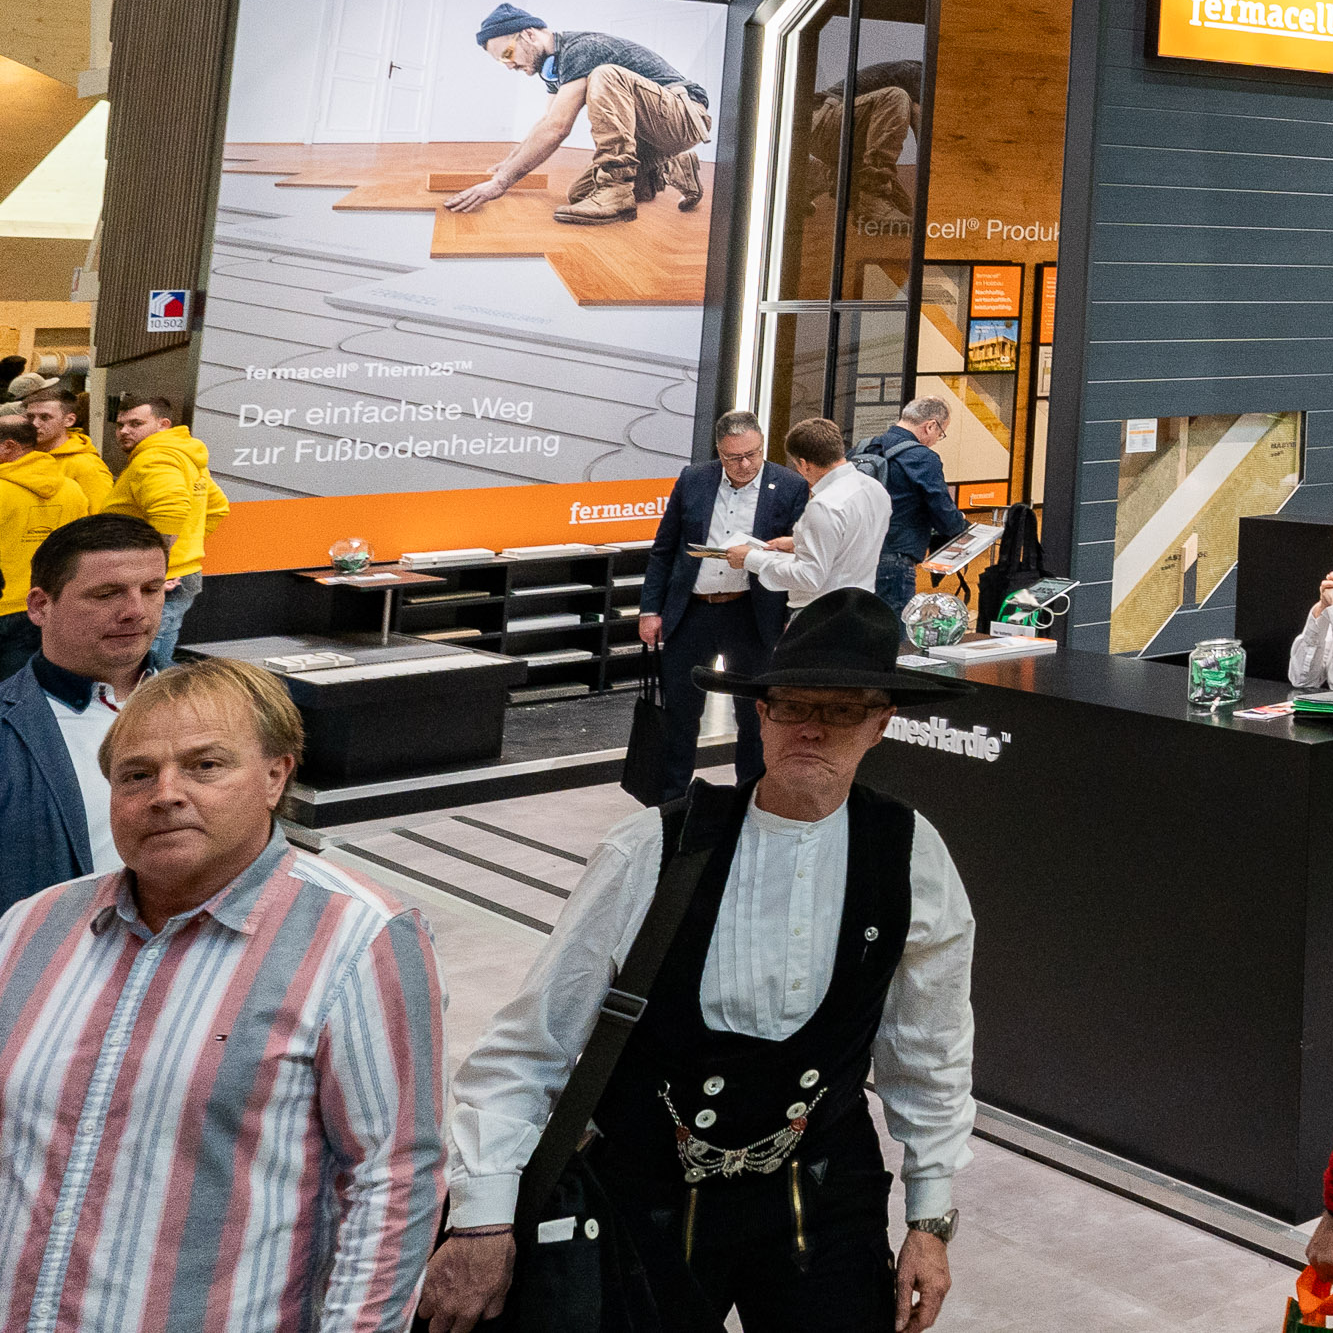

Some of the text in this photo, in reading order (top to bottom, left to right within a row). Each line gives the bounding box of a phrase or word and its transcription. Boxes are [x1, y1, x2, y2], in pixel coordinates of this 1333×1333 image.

[151, 319, 183, 328] 10.502
[238, 397, 533, 428] Der einfachste Weg
[232, 433, 560, 466] zur Fußbodenheizung
[883, 716, 1011, 762] mesHardie™
